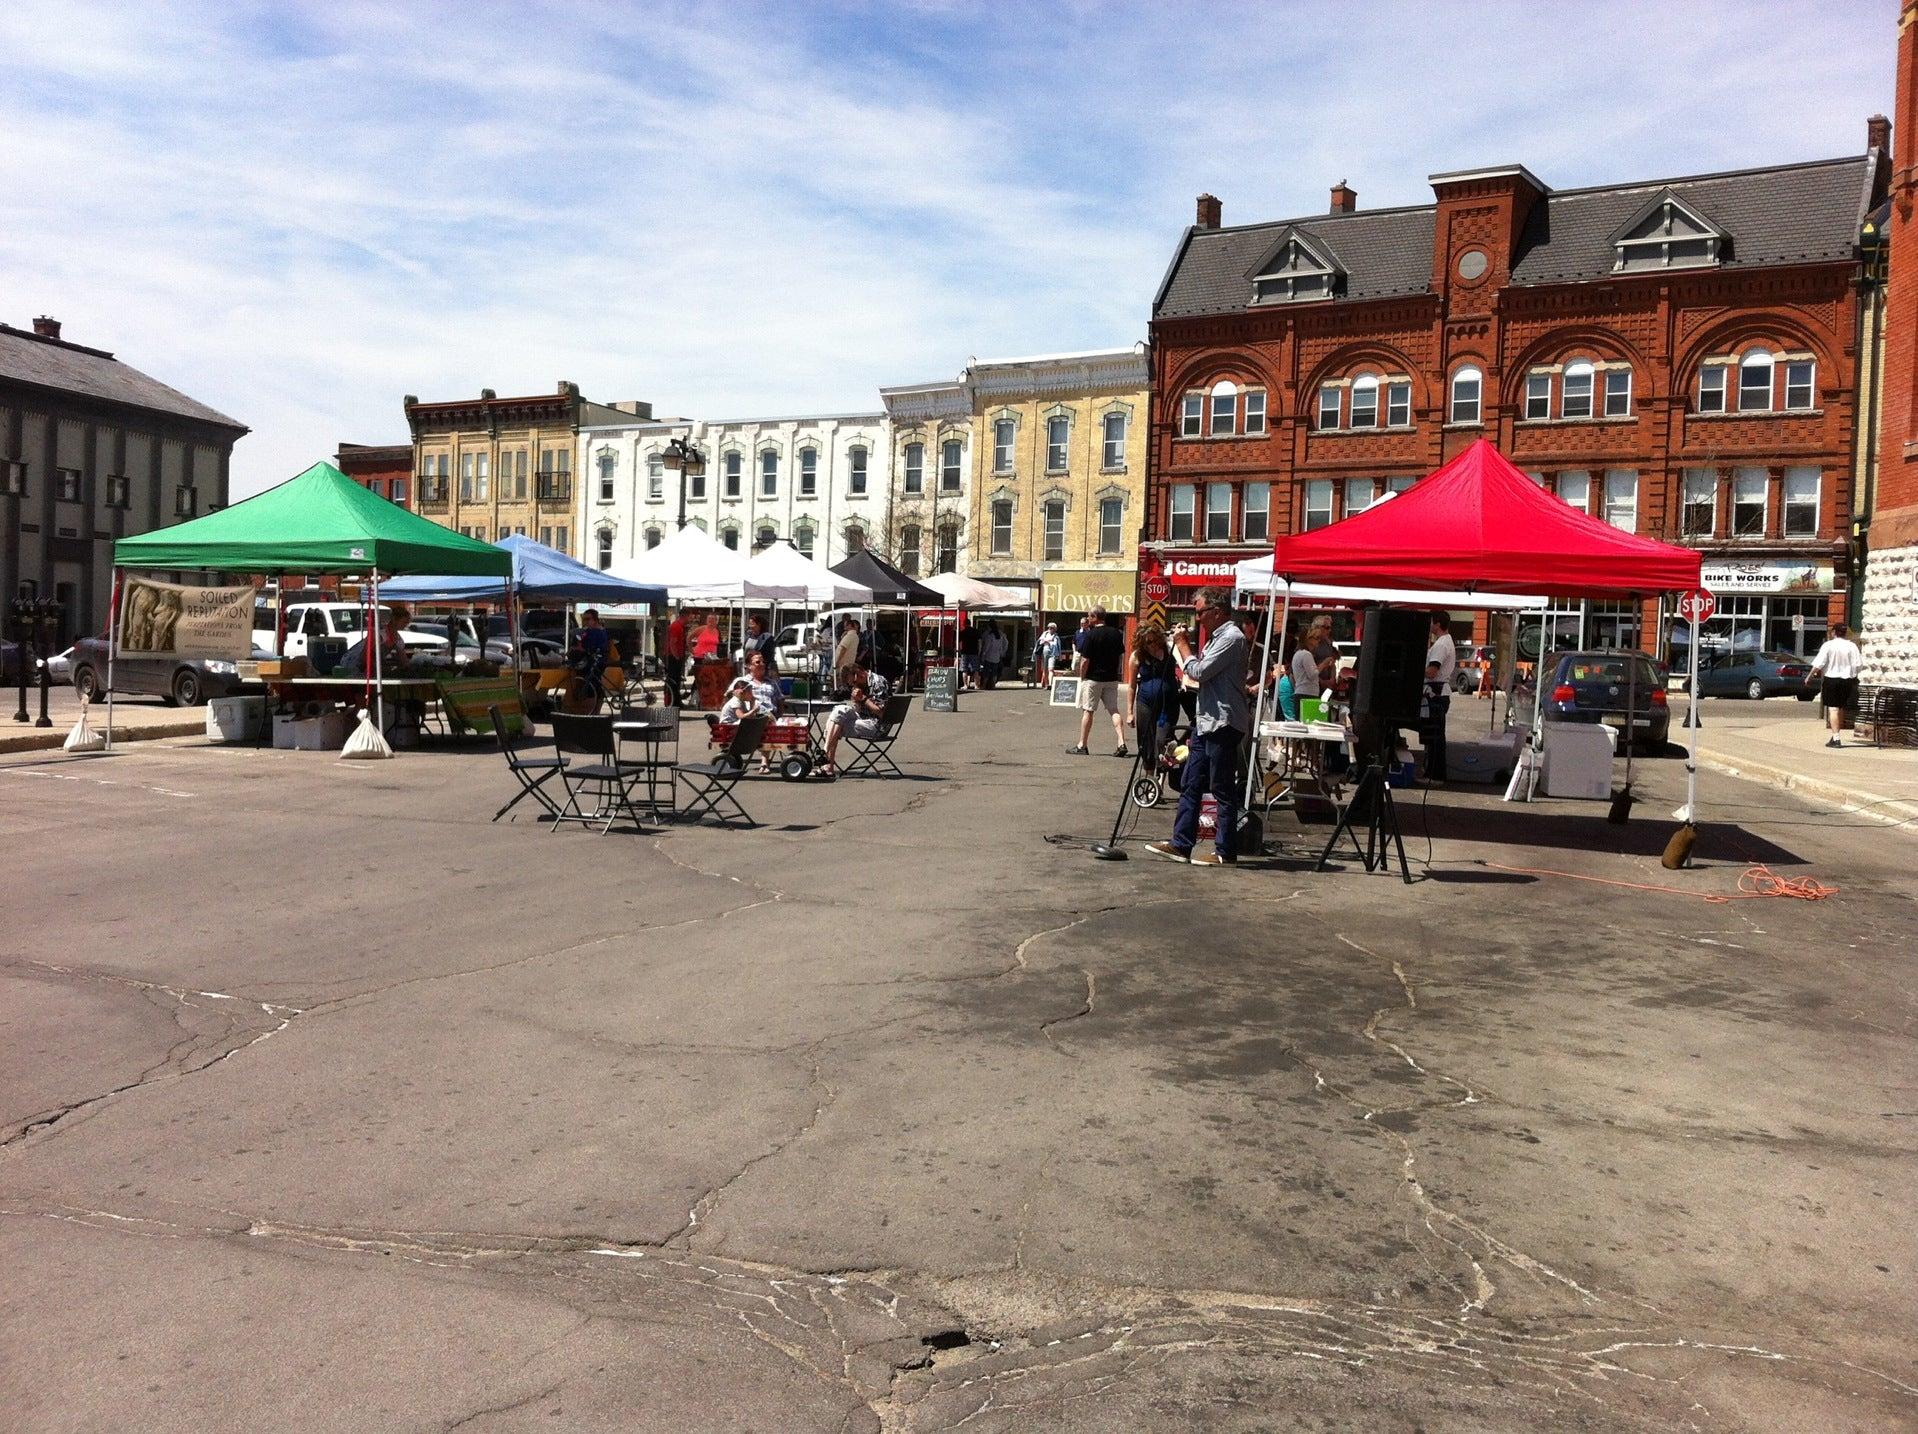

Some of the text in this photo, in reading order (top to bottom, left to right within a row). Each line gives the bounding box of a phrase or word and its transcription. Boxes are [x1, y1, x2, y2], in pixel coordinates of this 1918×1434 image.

[1147, 584, 1168, 593] STOP
[200, 591, 238, 604] SOILED
[1042, 583, 1133, 612] Flowers
[187, 605, 248, 619] REPUTATION
[1682, 598, 1713, 612] STOP
